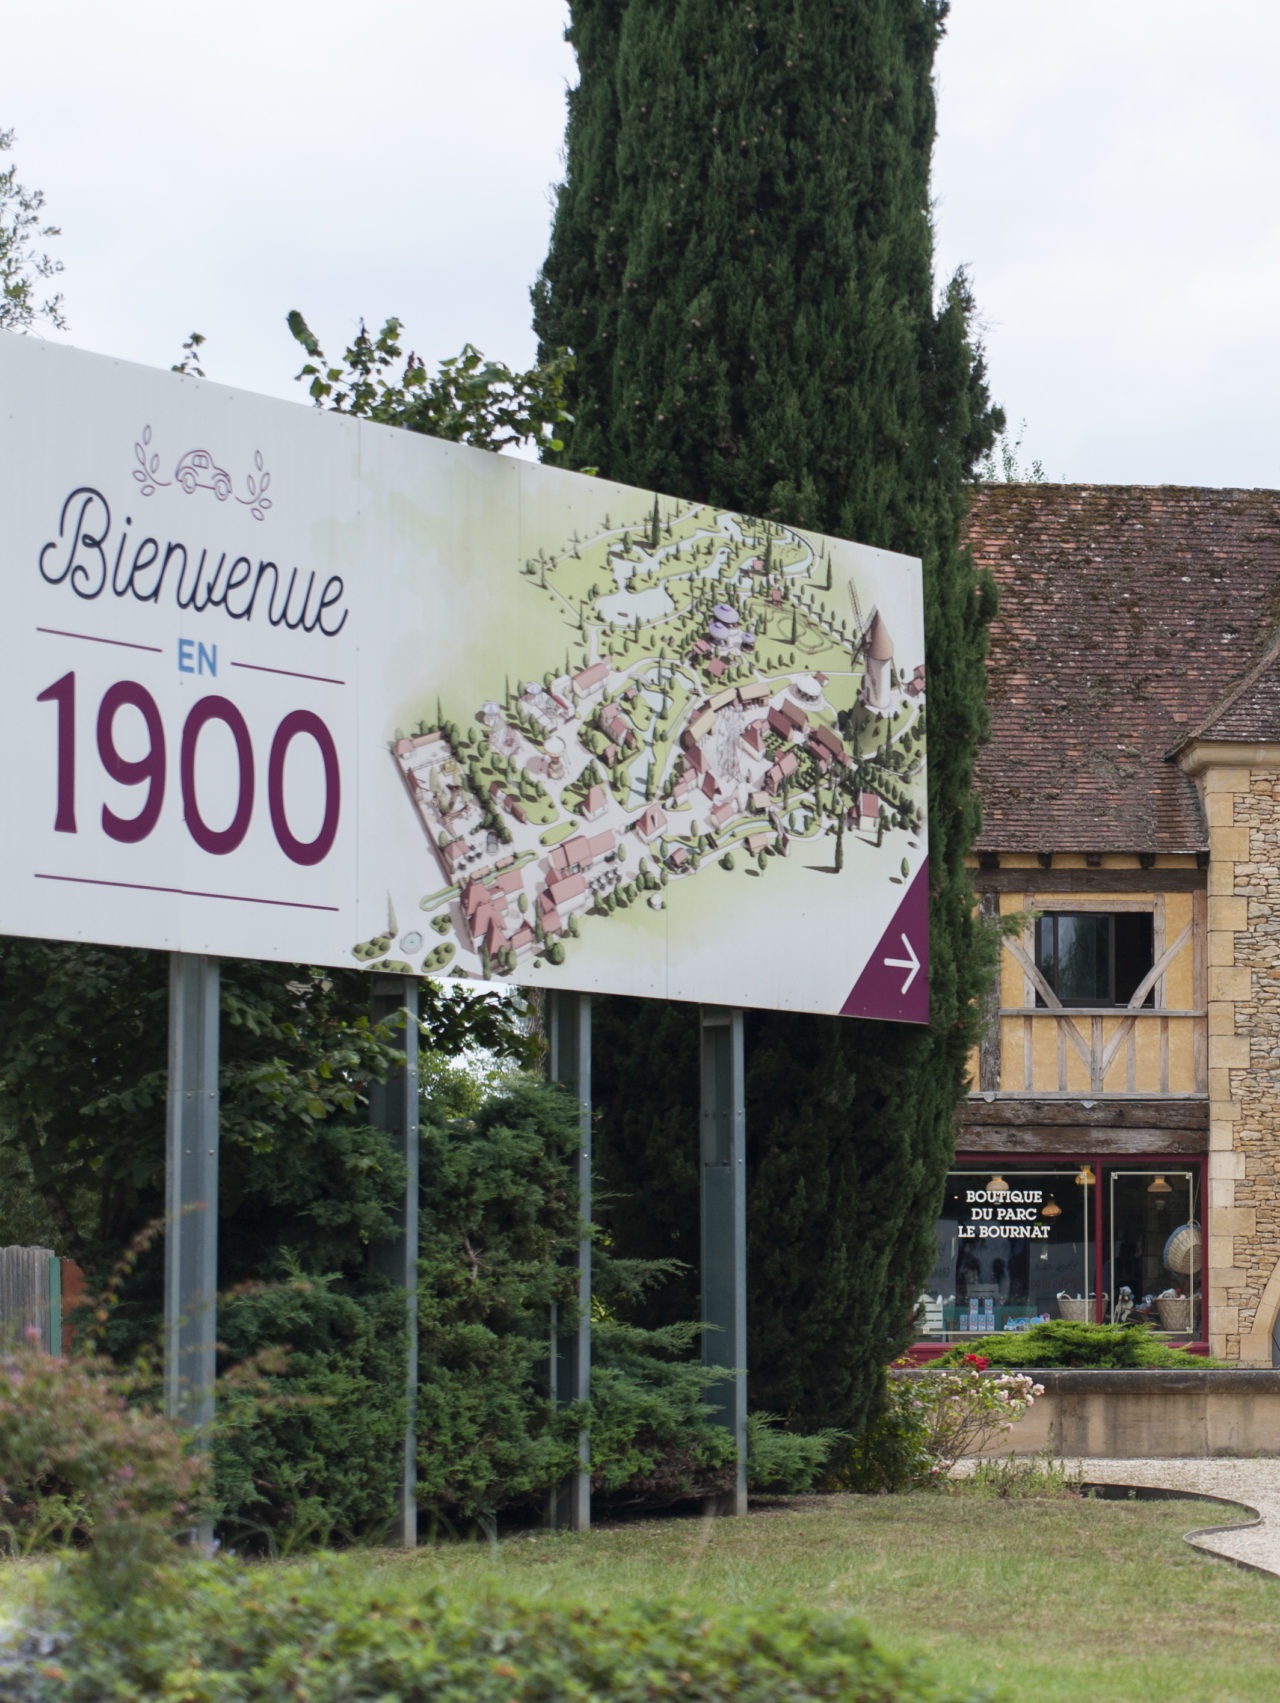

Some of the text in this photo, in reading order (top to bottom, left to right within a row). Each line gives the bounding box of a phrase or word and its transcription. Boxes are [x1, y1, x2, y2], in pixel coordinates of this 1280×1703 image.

[38, 487, 349, 637] Bienvenue
[177, 638, 218, 678] EN
[36, 671, 341, 866] 1900
[966, 1190, 1043, 1203] BOUTIQUE
[971, 1208, 1037, 1221] DU PARC
[957, 1225, 1051, 1238] LE BOURNAT
